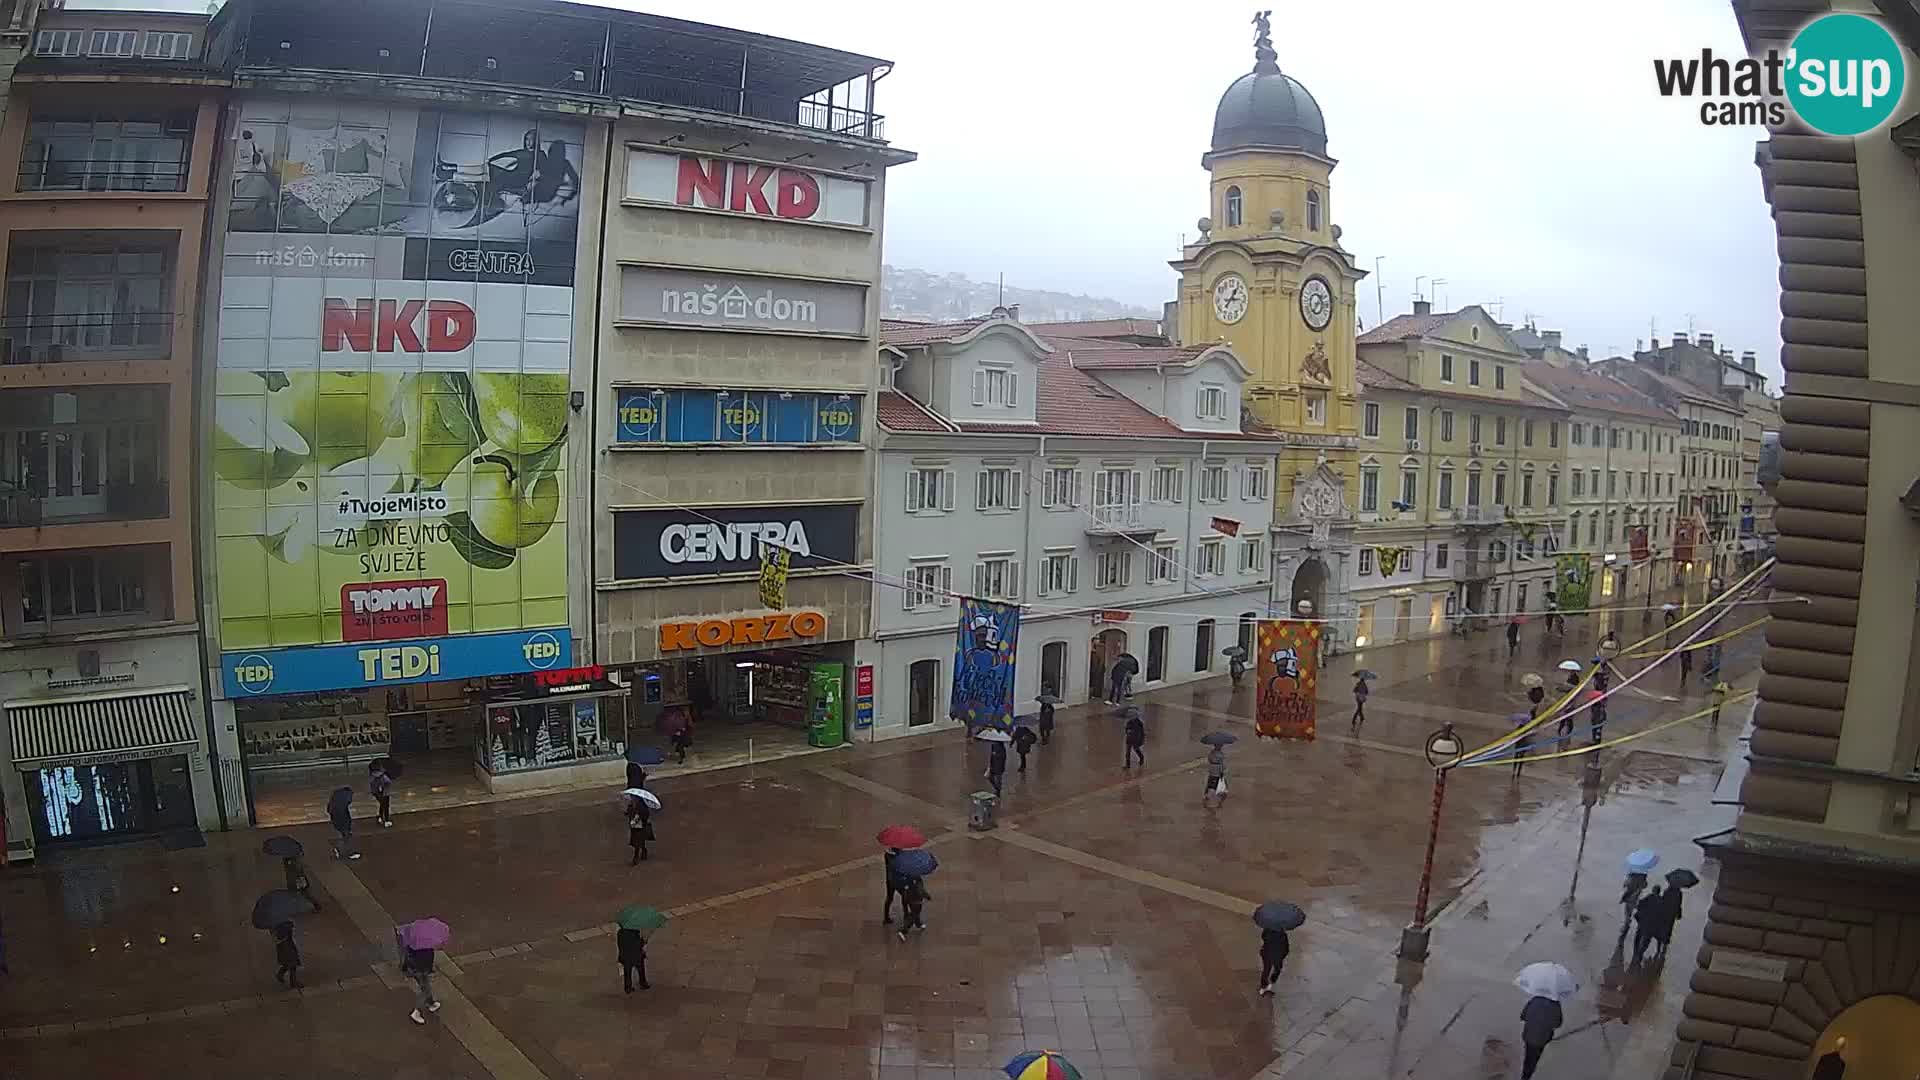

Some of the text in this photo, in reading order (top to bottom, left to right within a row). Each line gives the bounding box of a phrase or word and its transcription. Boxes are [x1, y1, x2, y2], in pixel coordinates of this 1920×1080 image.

[677, 158, 821, 219] NKD
[254, 246, 367, 268] naš dom
[449, 249, 534, 274] CENTRA
[662, 283, 816, 322] naš dom
[321, 297, 477, 353] NKD
[619, 407, 658, 424] TEDi
[723, 408, 760, 425] TEDi
[820, 411, 853, 426] TEDi
[338, 496, 447, 516] #TvojeMisto
[334, 523, 452, 548] ZA DNEVNO
[659, 520, 811, 564] CENTRA
[359, 547, 428, 574] SVJEŽE
[349, 586, 440, 614] TOMMY
[660, 612, 826, 651] KORZO
[522, 640, 561, 659] TEDi
[234, 664, 274, 683] TEDi
[358, 644, 441, 682] TEDi
